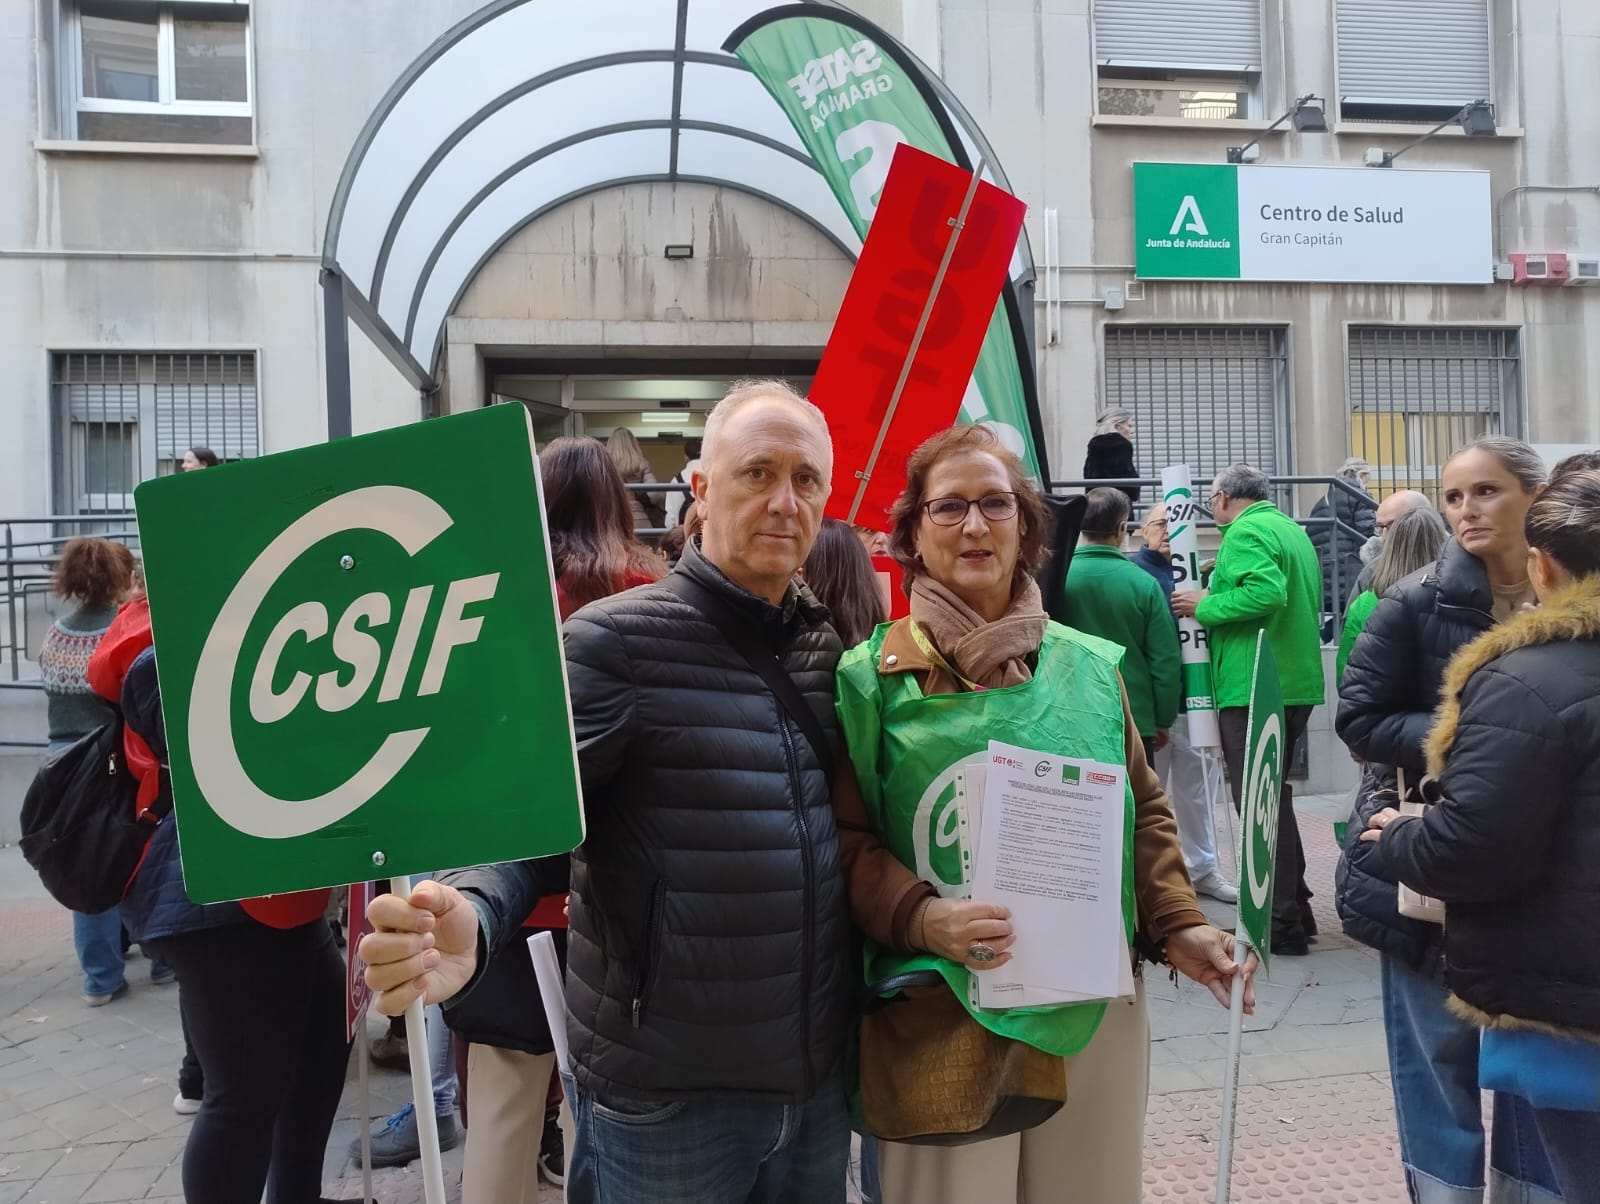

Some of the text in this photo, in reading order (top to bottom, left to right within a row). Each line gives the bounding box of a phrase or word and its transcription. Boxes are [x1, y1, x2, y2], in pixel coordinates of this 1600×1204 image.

[1260, 204, 1404, 223] Centro de Salud
[1146, 238, 1231, 249] Junta de Andalucía
[1260, 232, 1343, 247] Gran Capitán
[249, 572, 500, 724] CSIF
[993, 755, 1006, 765] UGT
